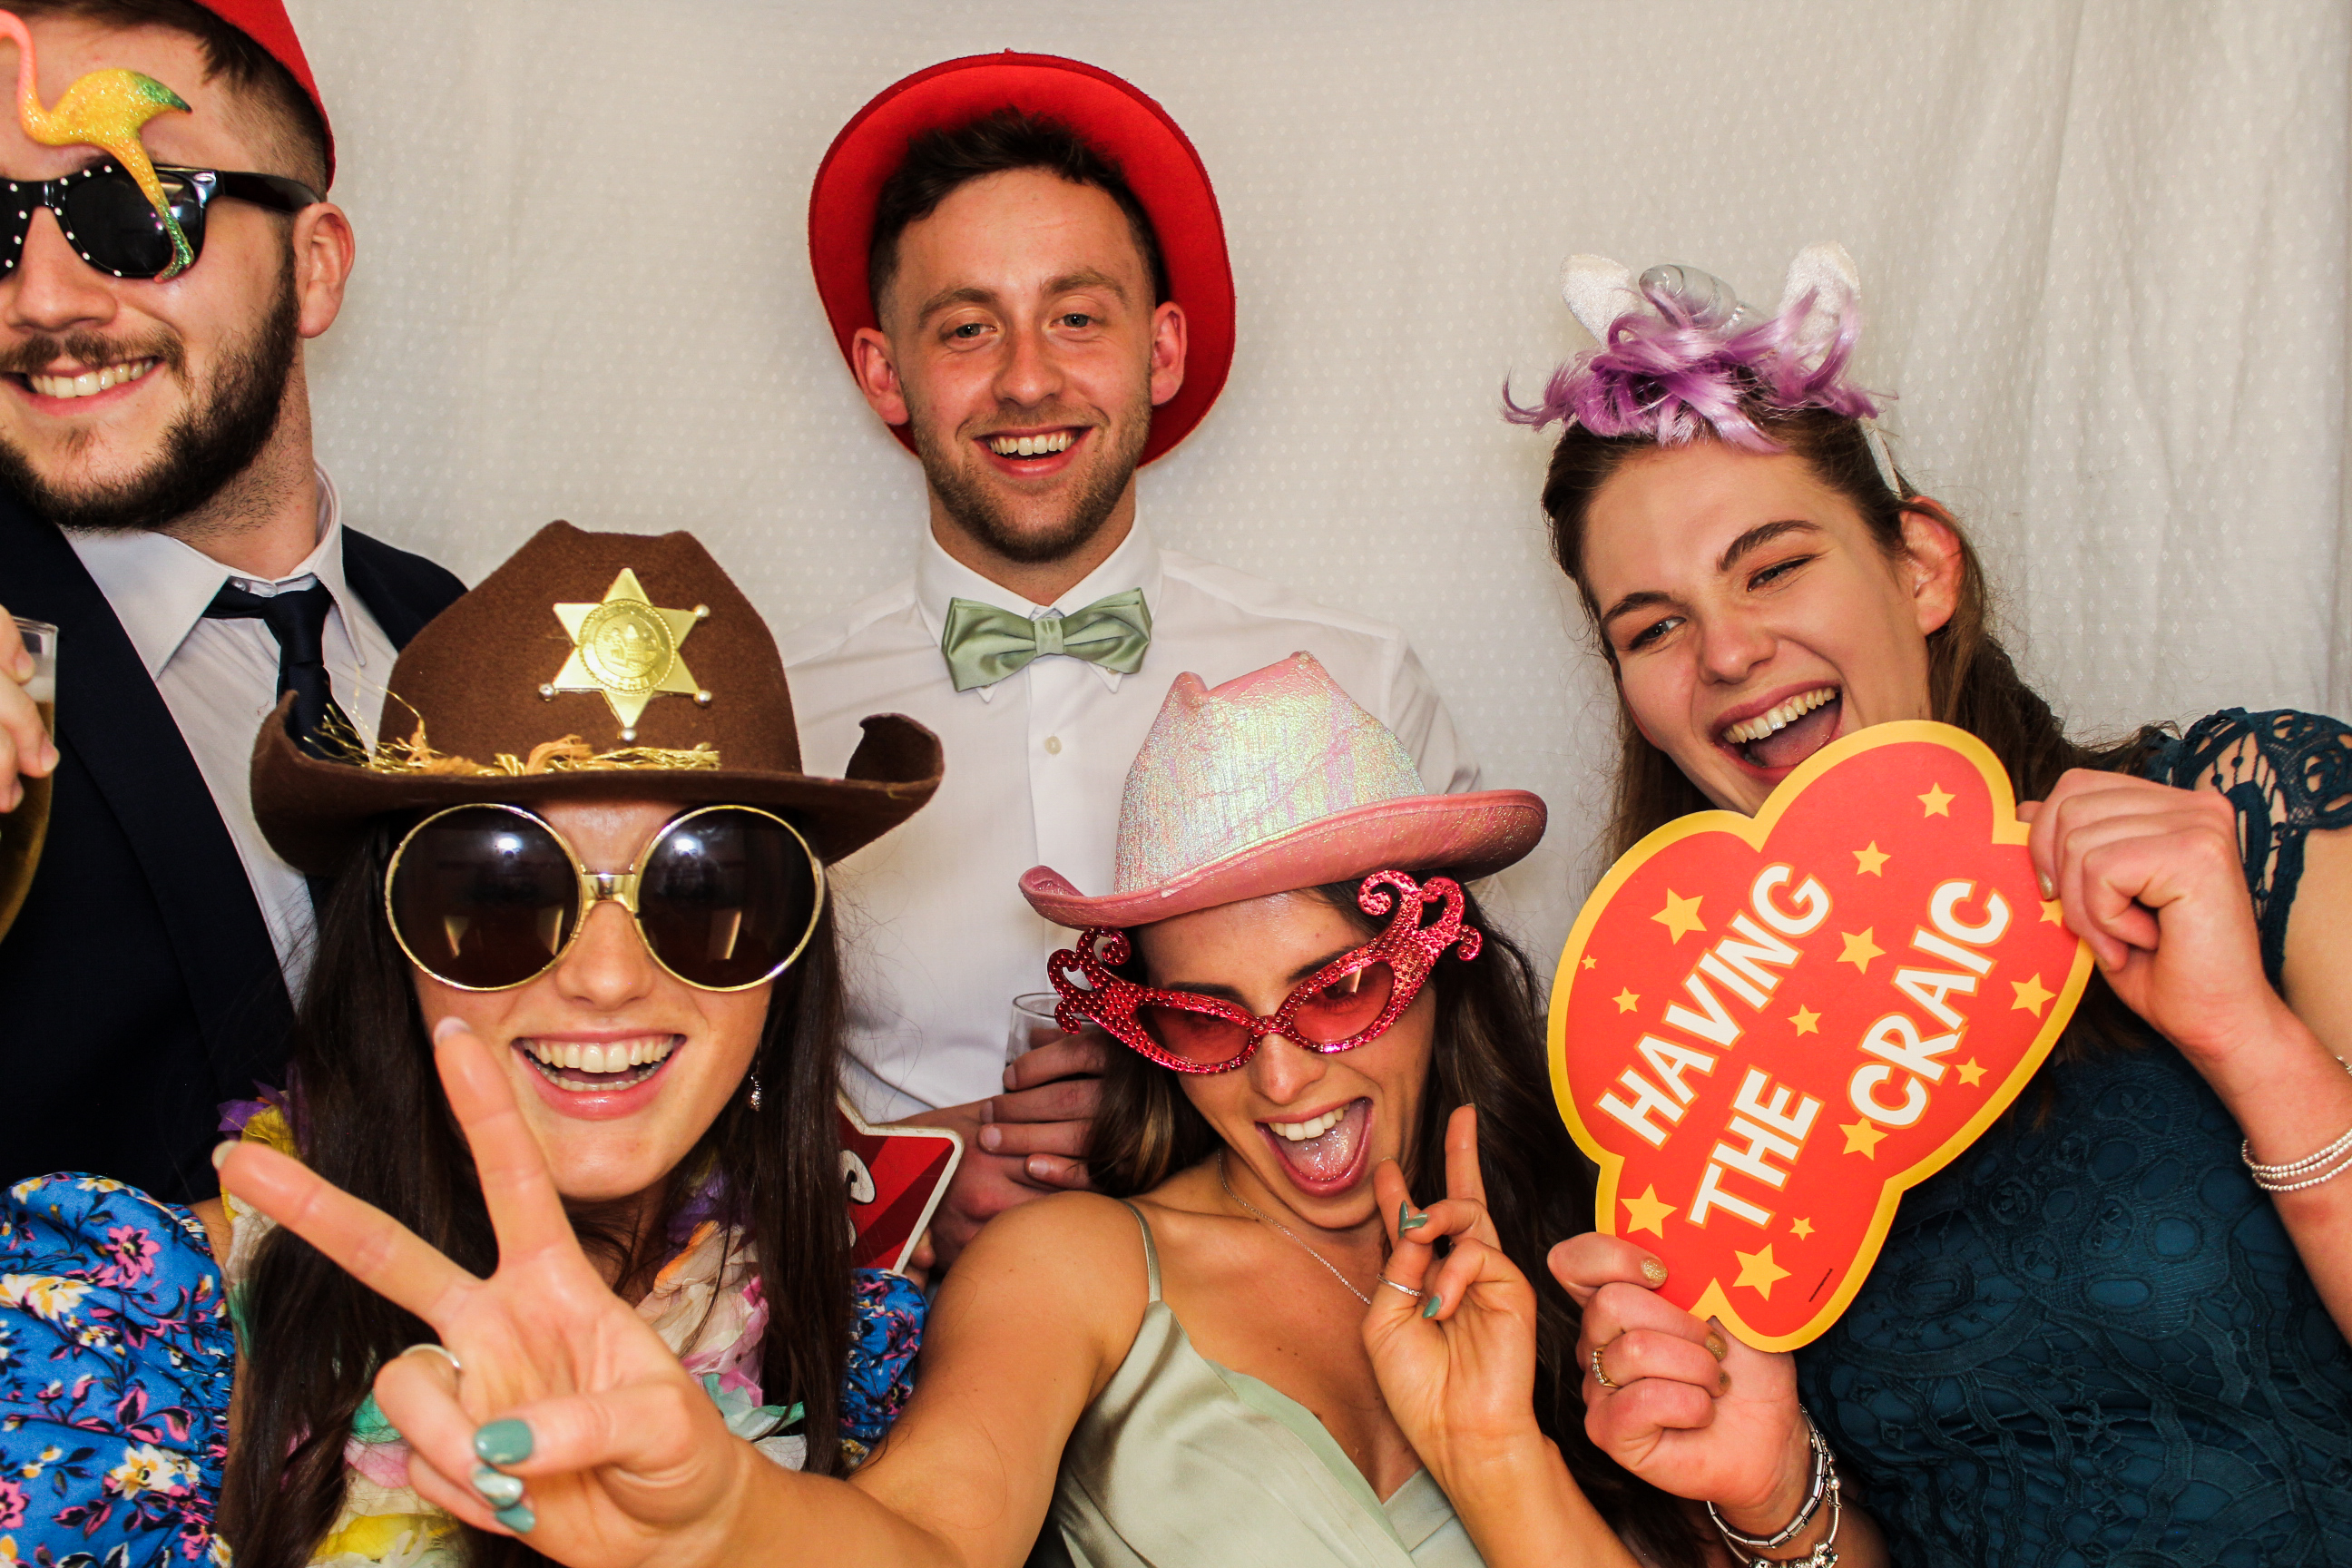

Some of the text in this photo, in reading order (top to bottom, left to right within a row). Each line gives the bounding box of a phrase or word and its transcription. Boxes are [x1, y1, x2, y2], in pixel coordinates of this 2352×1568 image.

[1597, 865, 1830, 1147] HAVING
[1849, 881, 2010, 1126] CRAIC
[1689, 1068, 1821, 1226] THE
